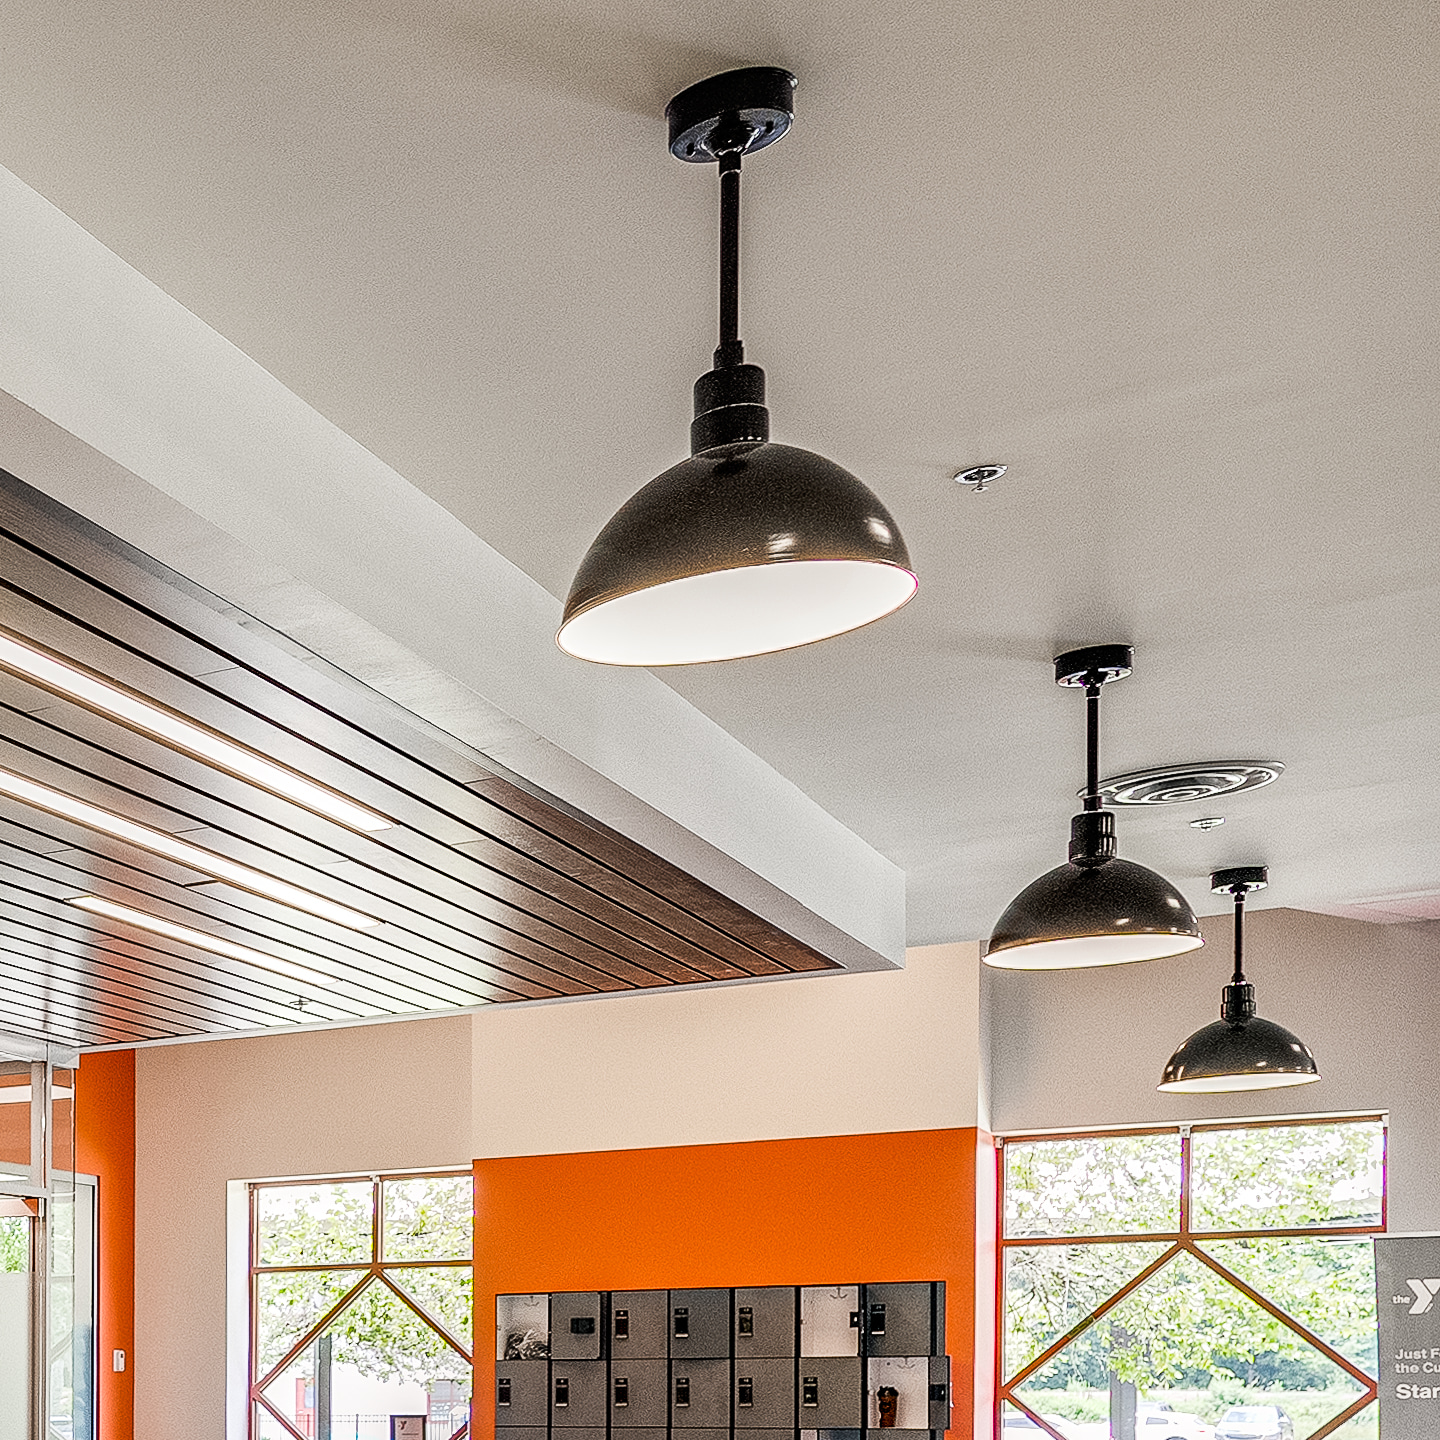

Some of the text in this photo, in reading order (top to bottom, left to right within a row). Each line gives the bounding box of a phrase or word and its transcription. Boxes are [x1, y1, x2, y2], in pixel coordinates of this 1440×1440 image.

[1392, 1295, 1411, 1305] the
[1395, 1348, 1440, 1360] Just F
[1395, 1363, 1420, 1374] the
[1395, 1383, 1440, 1400] Star
